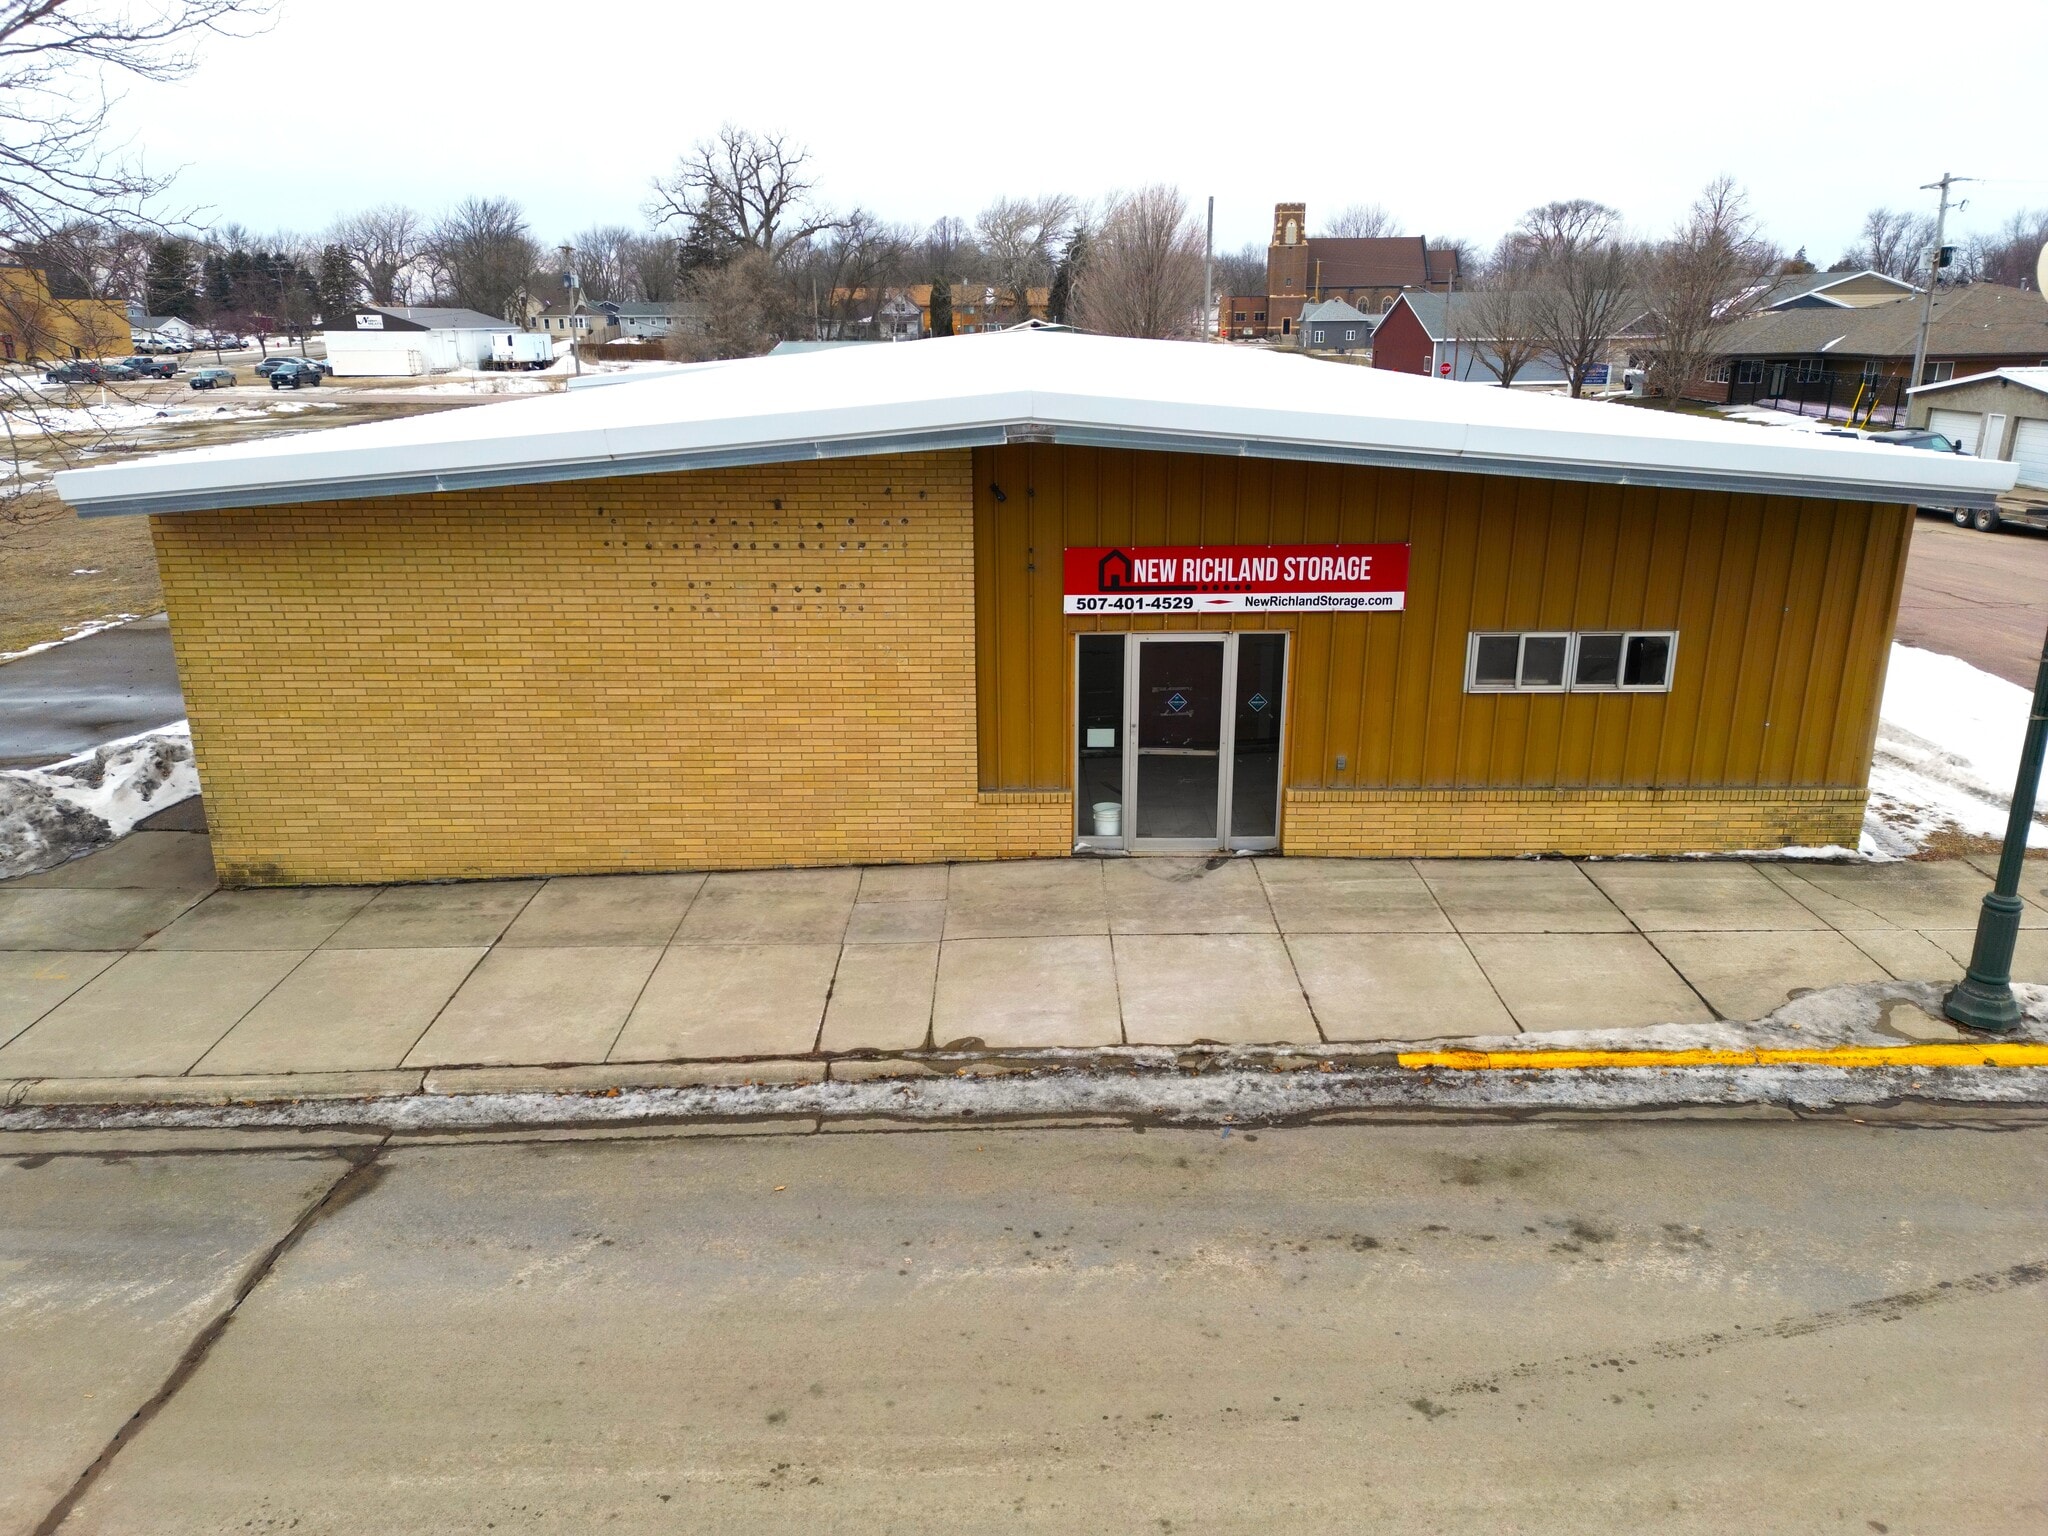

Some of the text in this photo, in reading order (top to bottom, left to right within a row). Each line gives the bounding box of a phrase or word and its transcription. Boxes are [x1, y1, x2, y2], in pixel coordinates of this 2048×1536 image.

[1134, 556, 1372, 583] NEW RICHLAND STORAGE
[1076, 595, 1393, 610] 507-401-4529 NewRichlandStorage.com
